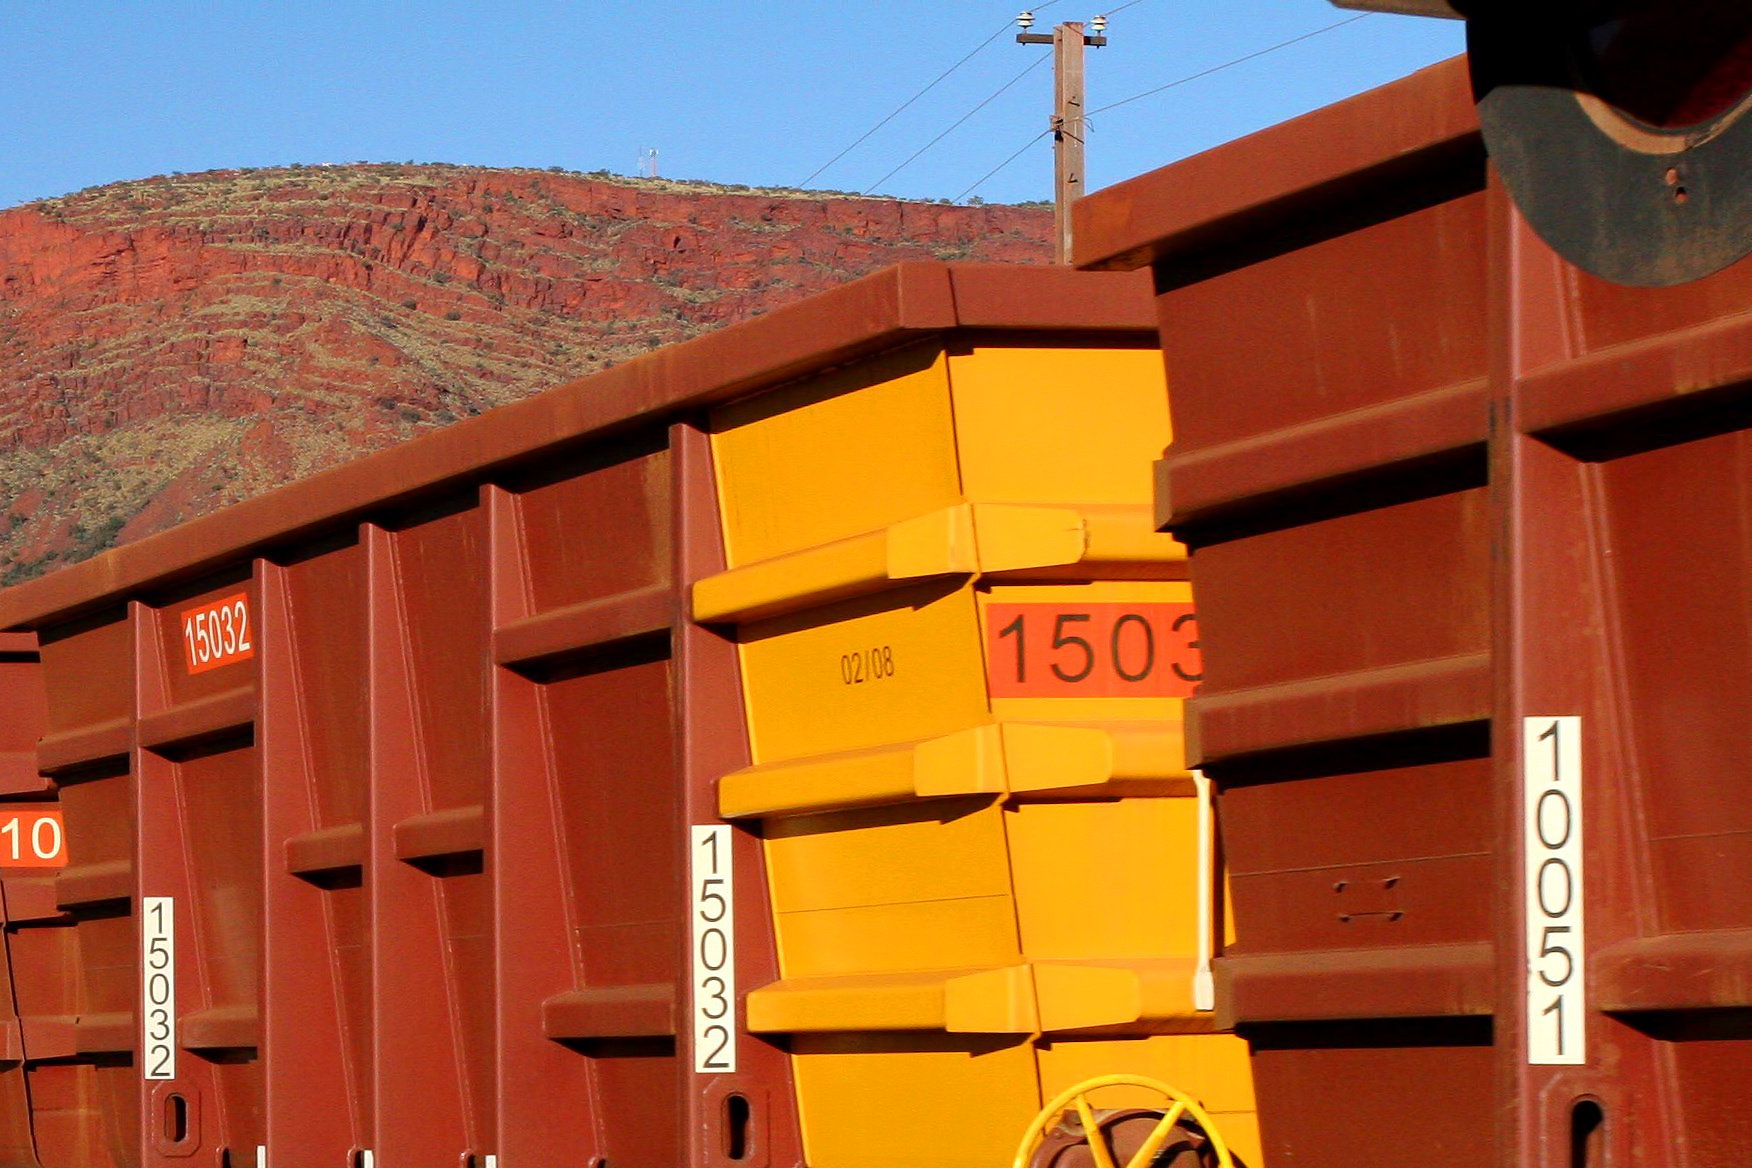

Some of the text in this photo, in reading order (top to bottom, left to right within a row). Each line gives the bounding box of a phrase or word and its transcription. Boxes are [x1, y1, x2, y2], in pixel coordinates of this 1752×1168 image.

[185, 600, 250, 666] 15032
[840, 645, 895, 685] 02/08
[1, 817, 62, 860] 10
[1536, 719, 1575, 1057] 10051
[149, 902, 171, 1077] 15032
[698, 830, 730, 1070] 15032
